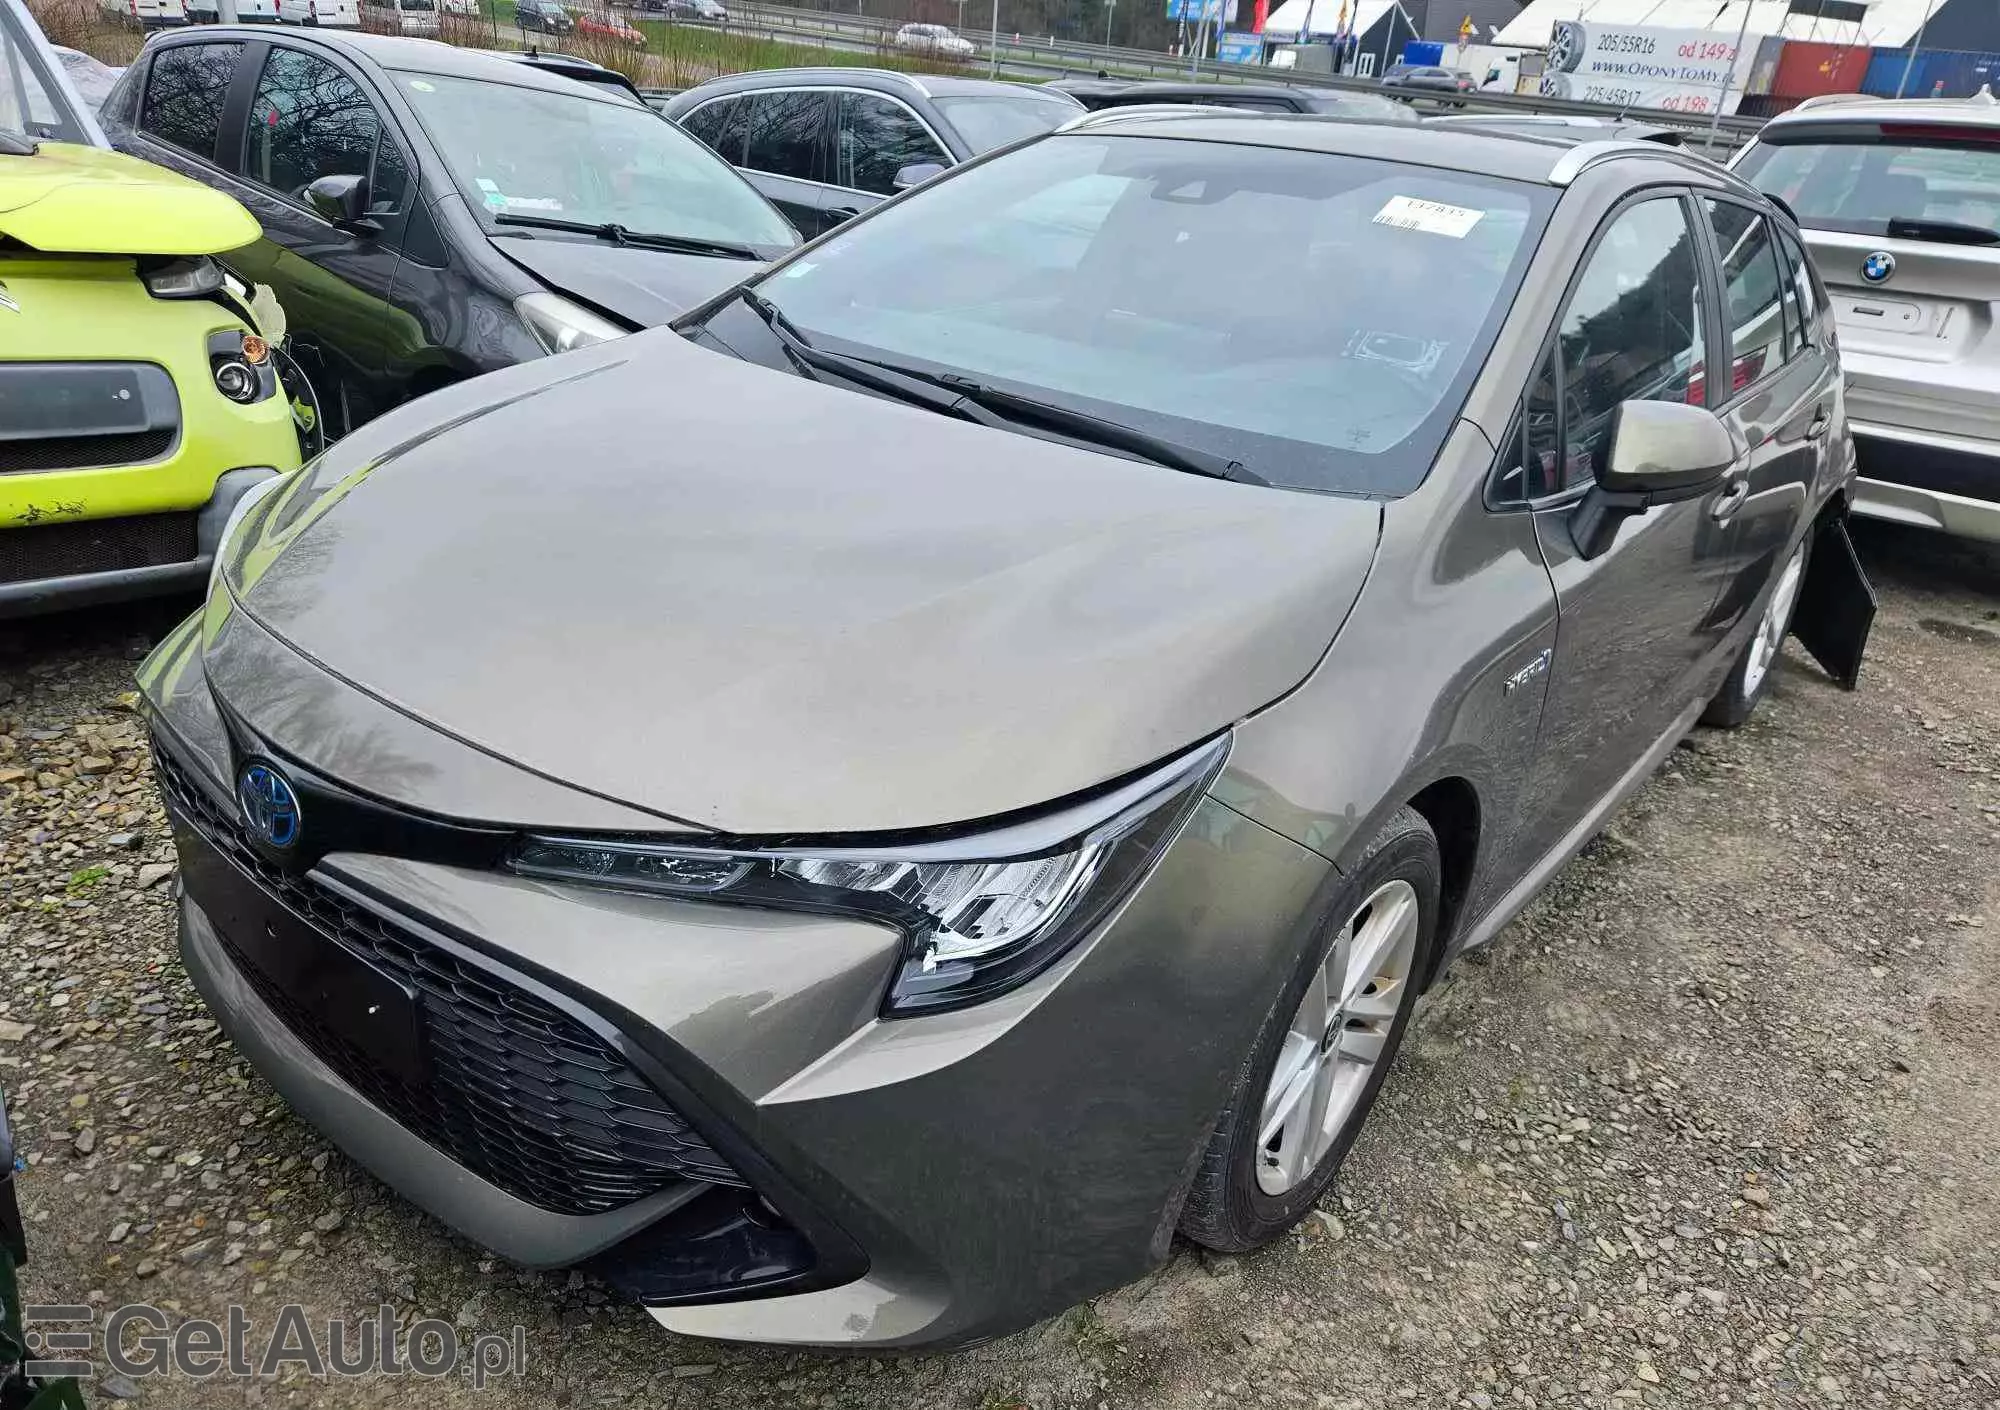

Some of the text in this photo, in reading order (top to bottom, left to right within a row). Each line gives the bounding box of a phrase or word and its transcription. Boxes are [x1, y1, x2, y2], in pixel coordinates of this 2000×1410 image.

[1597, 33, 1656, 54] 205/55R16
[1678, 40, 1697, 58] od
[1699, 43, 1726, 60] 149
